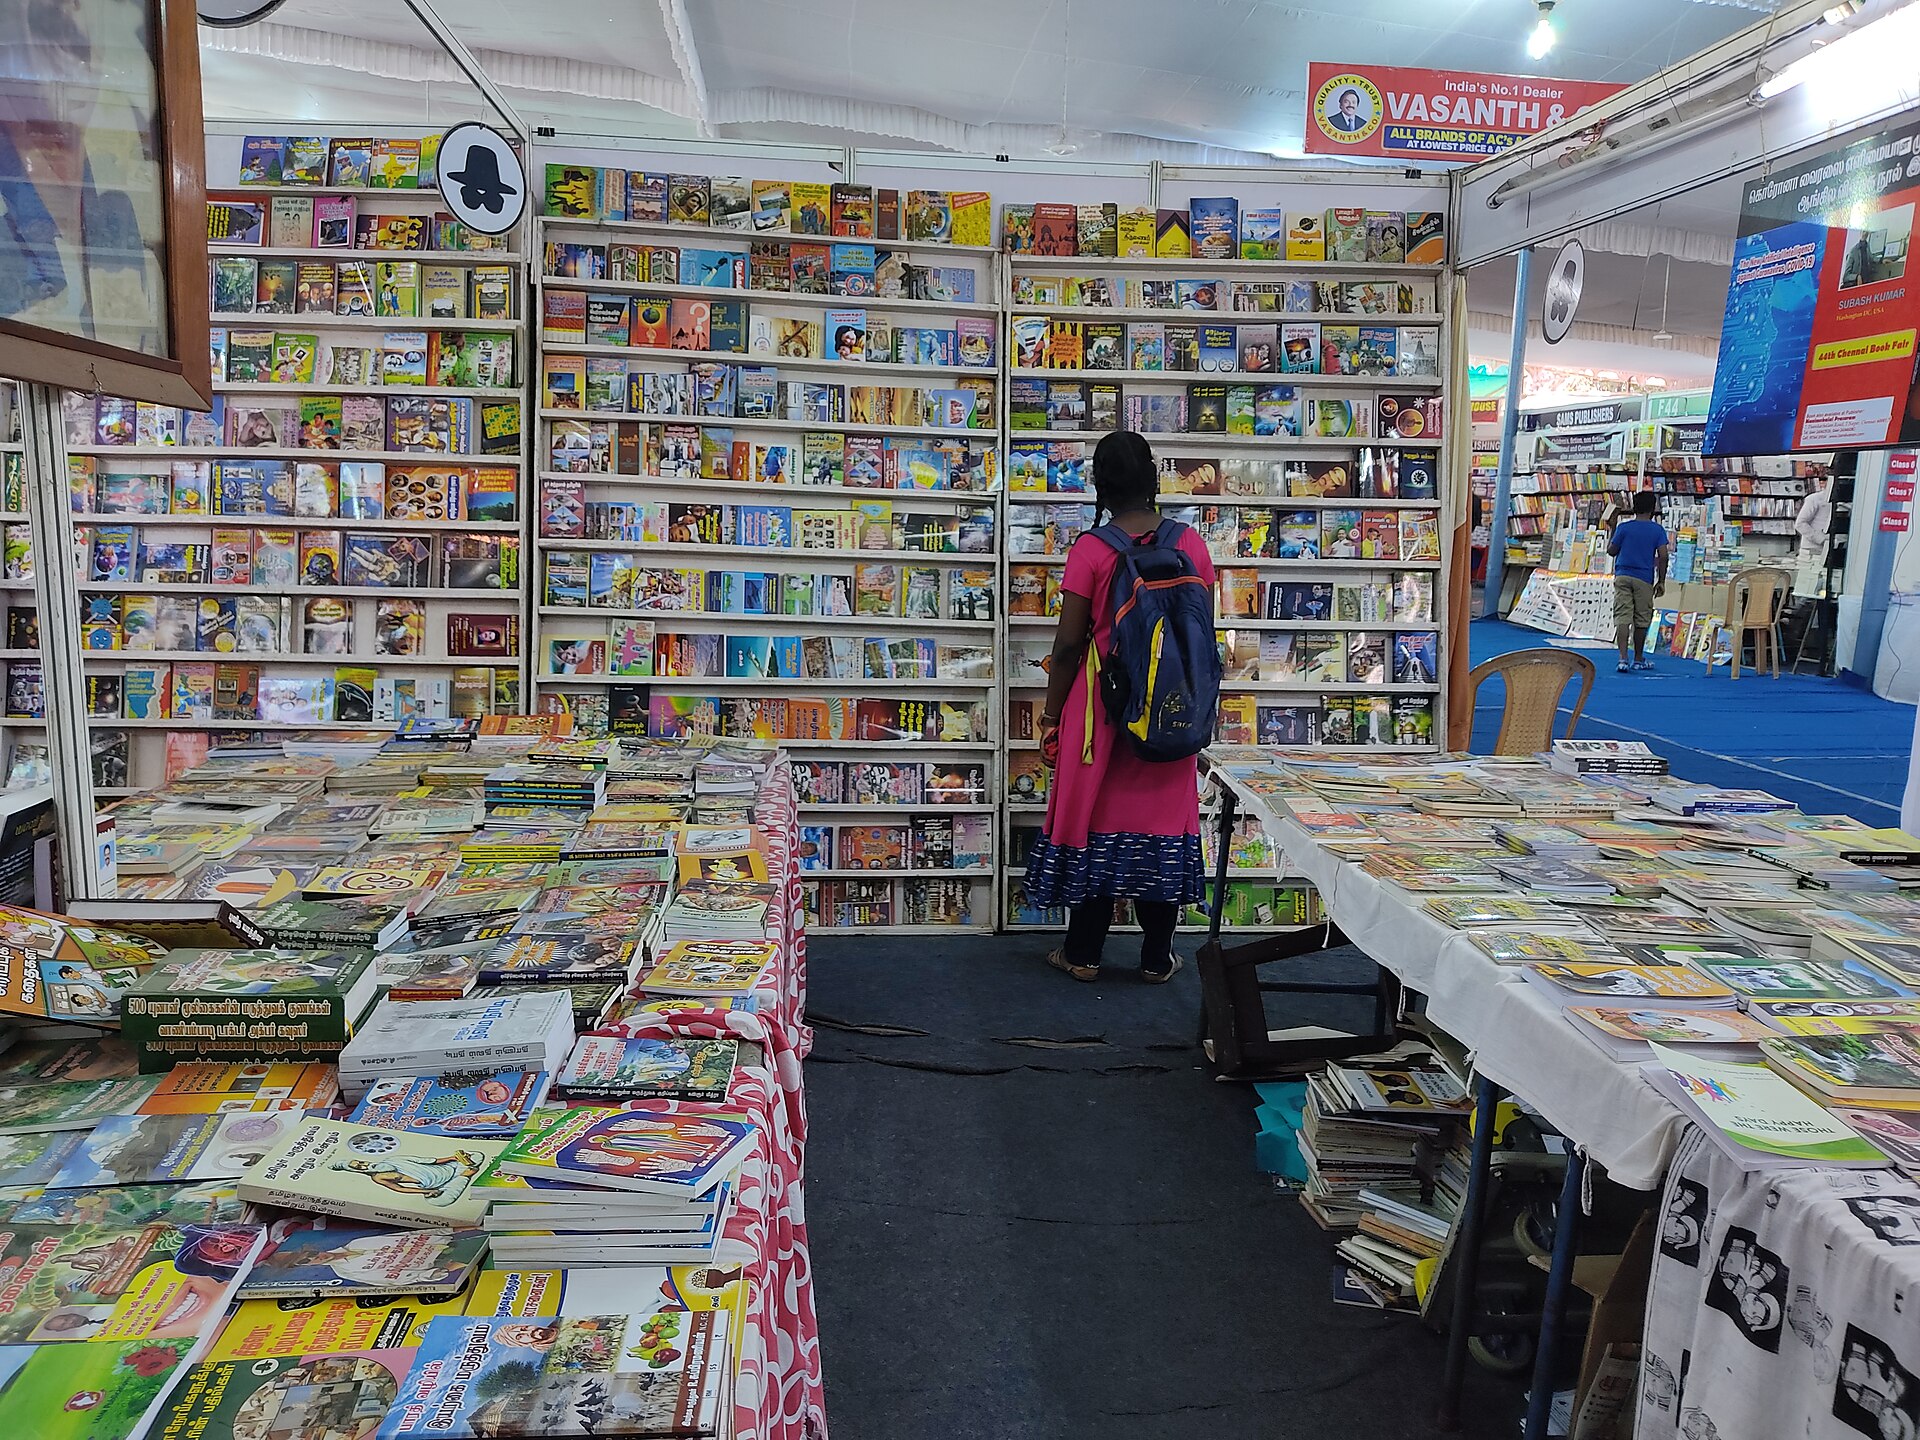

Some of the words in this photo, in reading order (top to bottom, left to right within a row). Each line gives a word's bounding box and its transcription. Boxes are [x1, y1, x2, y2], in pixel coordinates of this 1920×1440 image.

[1318, 77, 1349, 105] QUALITY
[1359, 80, 1379, 106] TRUST
[1445, 80, 1487, 93] India's
[1491, 84, 1519, 96] No.1
[1522, 86, 1563, 99] Dealer
[1386, 92, 1539, 129] VASANTH
[1319, 116, 1360, 140] VASANTH
[1390, 127, 1414, 140] ALL
[1417, 128, 1466, 142] BRANDS
[1468, 130, 1484, 143] OF
[1487, 131, 1514, 145] AC's
[1406, 140, 1418, 149] AT
[1420, 141, 1458, 151] LOWEST
[1459, 143, 1486, 152] PRICE
[1488, 144, 1494, 152] &
[1749, 175, 1799, 204] கொரோனா
[1838, 294, 1872, 310] SUBASH
[1874, 288, 1906, 304] KUMAR
[1818, 350, 1836, 362] 44th
[1838, 346, 1868, 359] Chennai
[1869, 342, 1890, 356] Book
[1892, 338, 1909, 352] Fair
[1471, 401, 1496, 412] OUSE
[1658, 399, 1679, 416] F44
[1557, 411, 1573, 426] SAMS
[1574, 406, 1614, 424] PUBLISHERS
[1891, 459, 1909, 468] Class
[1910, 460, 1915, 469] 6
[1889, 486, 1907, 496] Class
[1908, 487, 1912, 496] 7
[1882, 517, 1900, 526] Class
[20, 948, 41, 1004] கதைகள்
[128, 998, 146, 1014] 500
[148, 998, 180, 1018] யுனானி
[182, 998, 240, 1018] மூலிகைகளின்
[242, 1000, 285, 1018] மருத்துவக்
[287, 1000, 330, 1018] குணங்கள்
[159, 1021, 215, 1039] வாணியம்பாடி
[217, 1022, 245, 1037] டாக்டர்
[248, 1022, 275, 1038] அக்பர்
[444, 1050, 465, 1059] நாடி
[468, 1048, 492, 1059] நலம்
[495, 1046, 528, 1056] நாளும்
[1730, 1120, 1755, 1129] THE
[1755, 1124, 1792, 1133] WERE
[1771, 1119, 1814, 1127] HAPPY
[265, 1157, 287, 1179] தமிழர்
[286, 1125, 320, 1158] மருத்துவம்
[290, 1156, 316, 1181] அன்றும்
[312, 1131, 339, 1155] இன்றும்
[268, 1191, 297, 1200] தமிழர்
[300, 1194, 346, 1207] மருத்துவம்
[338, 1310, 383, 1349] எப்படி?
[427, 1383, 466, 1429] இயற்கை
[454, 1322, 491, 1380] மருத்துவம்
[202, 1365, 235, 1413] பதில்கள்
